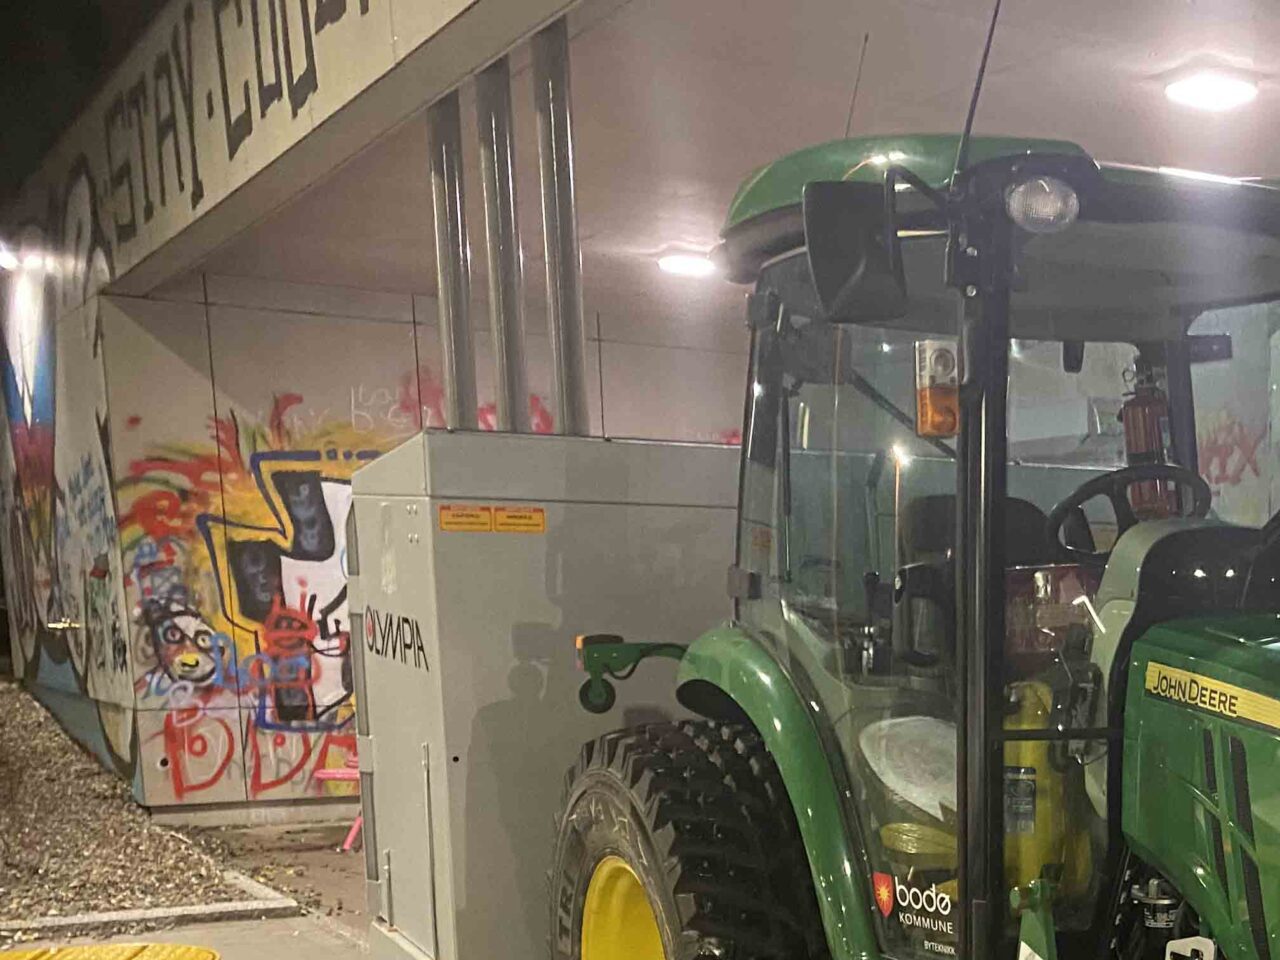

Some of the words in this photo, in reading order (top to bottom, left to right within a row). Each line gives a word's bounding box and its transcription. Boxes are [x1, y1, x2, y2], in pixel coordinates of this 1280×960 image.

[365, 604, 430, 673] OLYMPIA
[1153, 669, 1187, 698] JOHN
[1188, 678, 1239, 715] DEERE
[899, 912, 953, 934] KOMMUNE
